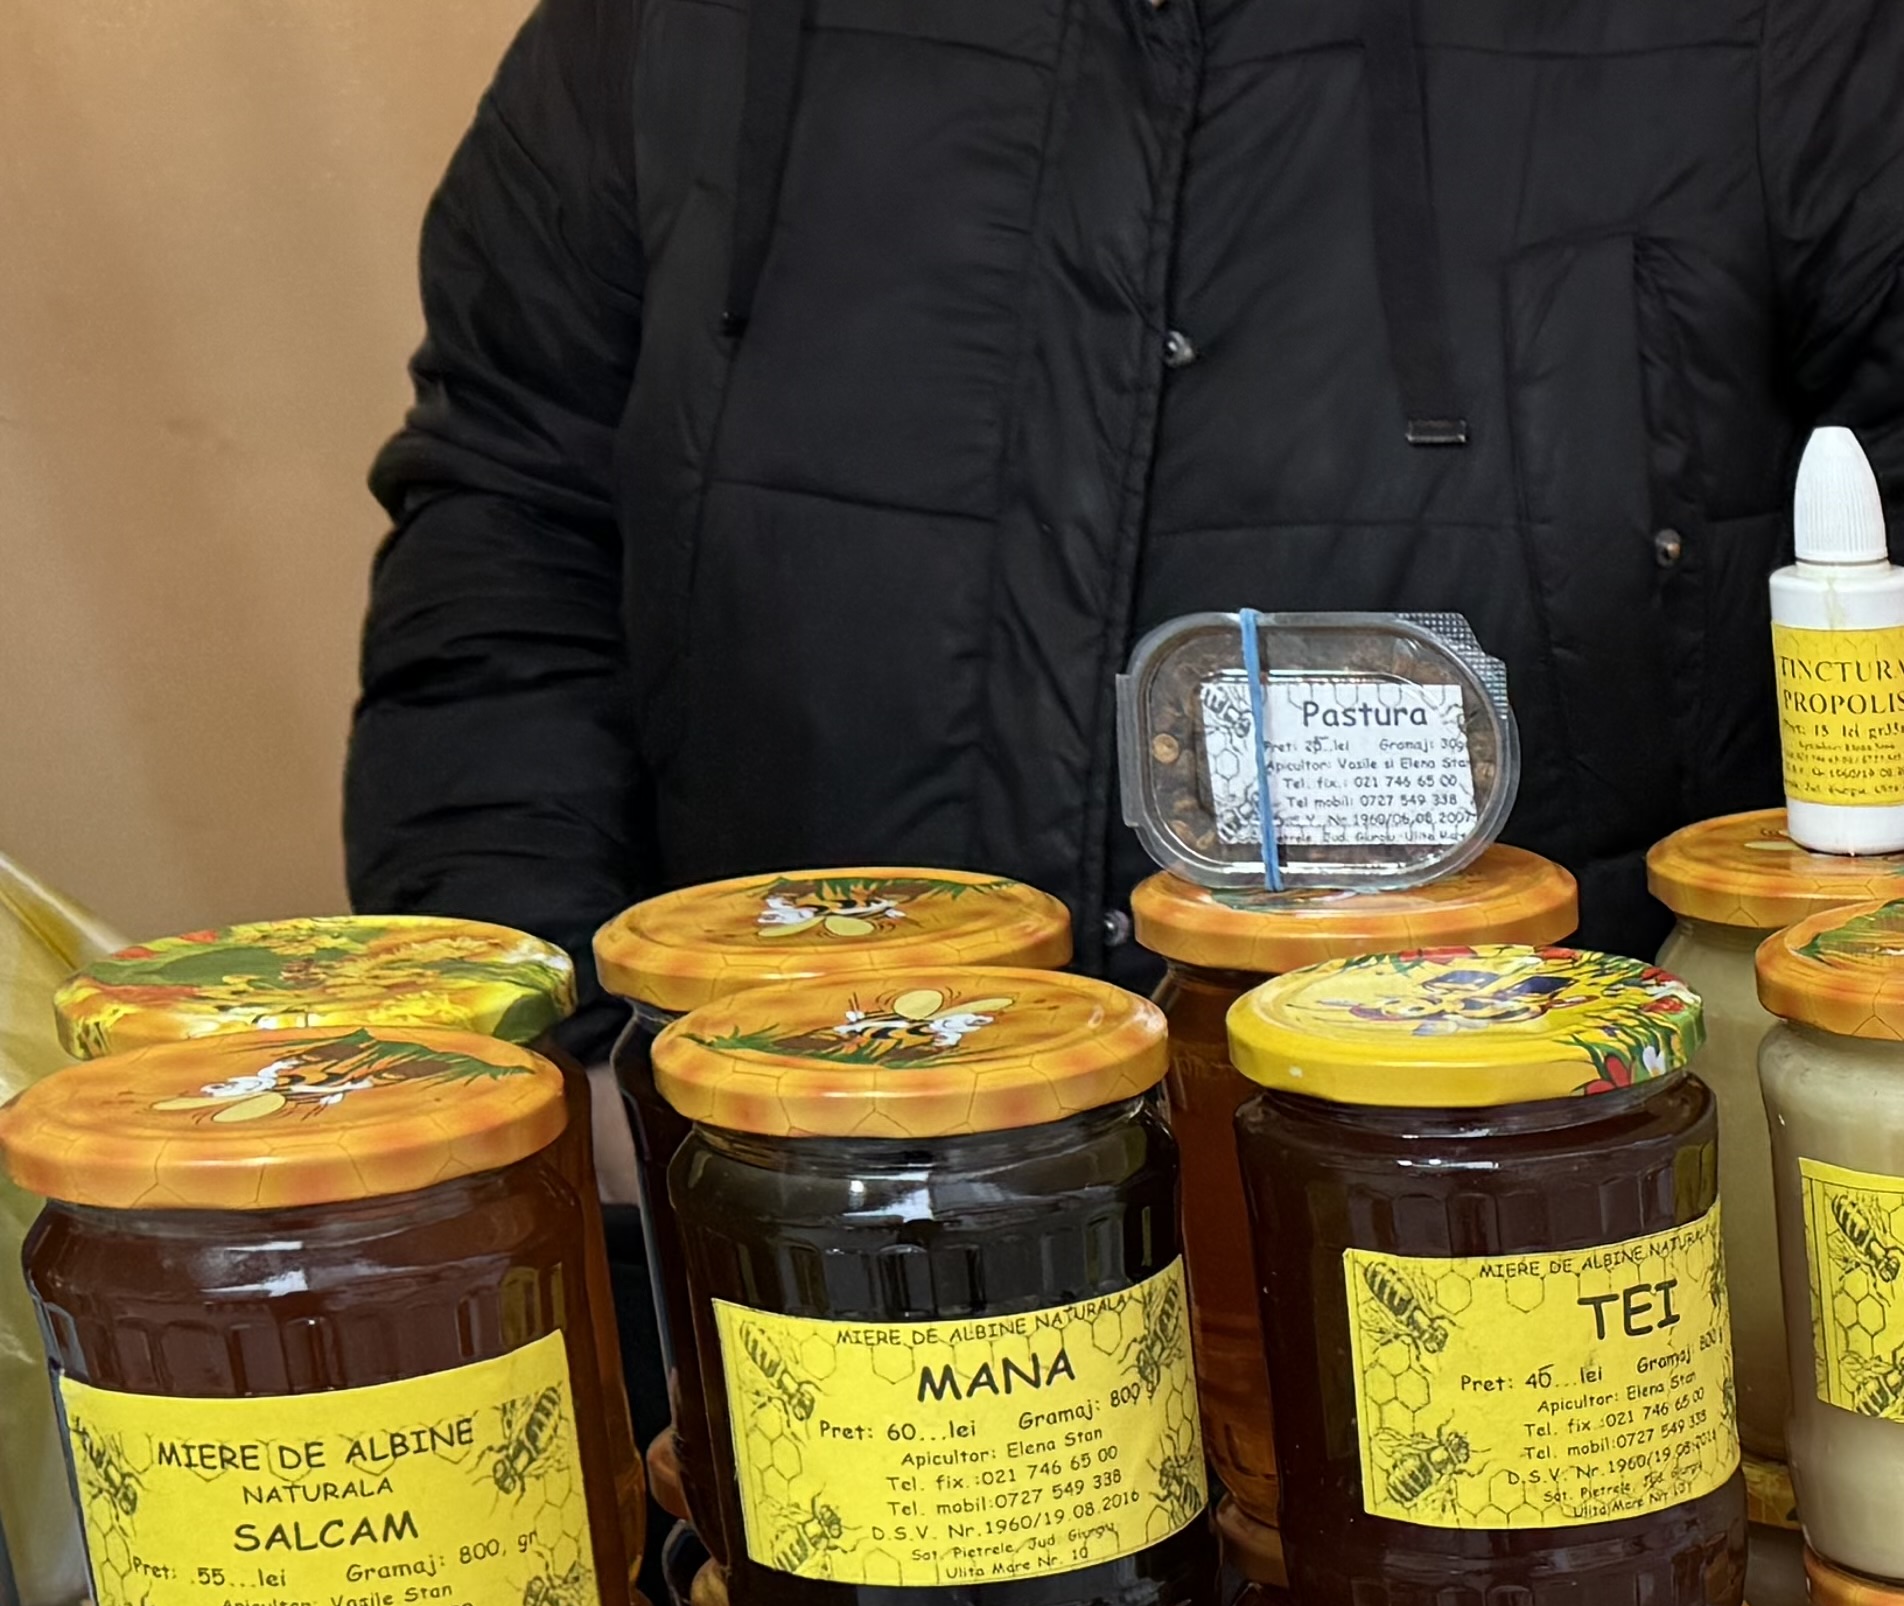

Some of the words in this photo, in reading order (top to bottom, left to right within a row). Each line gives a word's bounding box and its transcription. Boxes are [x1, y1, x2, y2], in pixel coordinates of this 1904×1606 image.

[1303, 700, 1428, 727] Pastura
[1577, 1279, 1680, 1341] TEI
[836, 1330, 901, 1347] MIERE
[912, 1328, 939, 1345] DE
[950, 1318, 1028, 1343] ALBINE
[918, 1348, 1076, 1402] MANA
[820, 1421, 873, 1439] Pret:
[1018, 1399, 1102, 1431] Gramaj:
[156, 1442, 259, 1472] MIERE
[279, 1441, 326, 1470] DE
[346, 1417, 476, 1462] ALBINE
[901, 1447, 997, 1468] Apicultor:
[1007, 1436, 1056, 1458] Elena
[1063, 1426, 1103, 1449] Stan
[242, 1477, 394, 1505] NATURALA
[234, 1510, 419, 1552] SALCAM
[346, 1555, 446, 1585] Gramaj:
[405, 1581, 452, 1601] Stan
